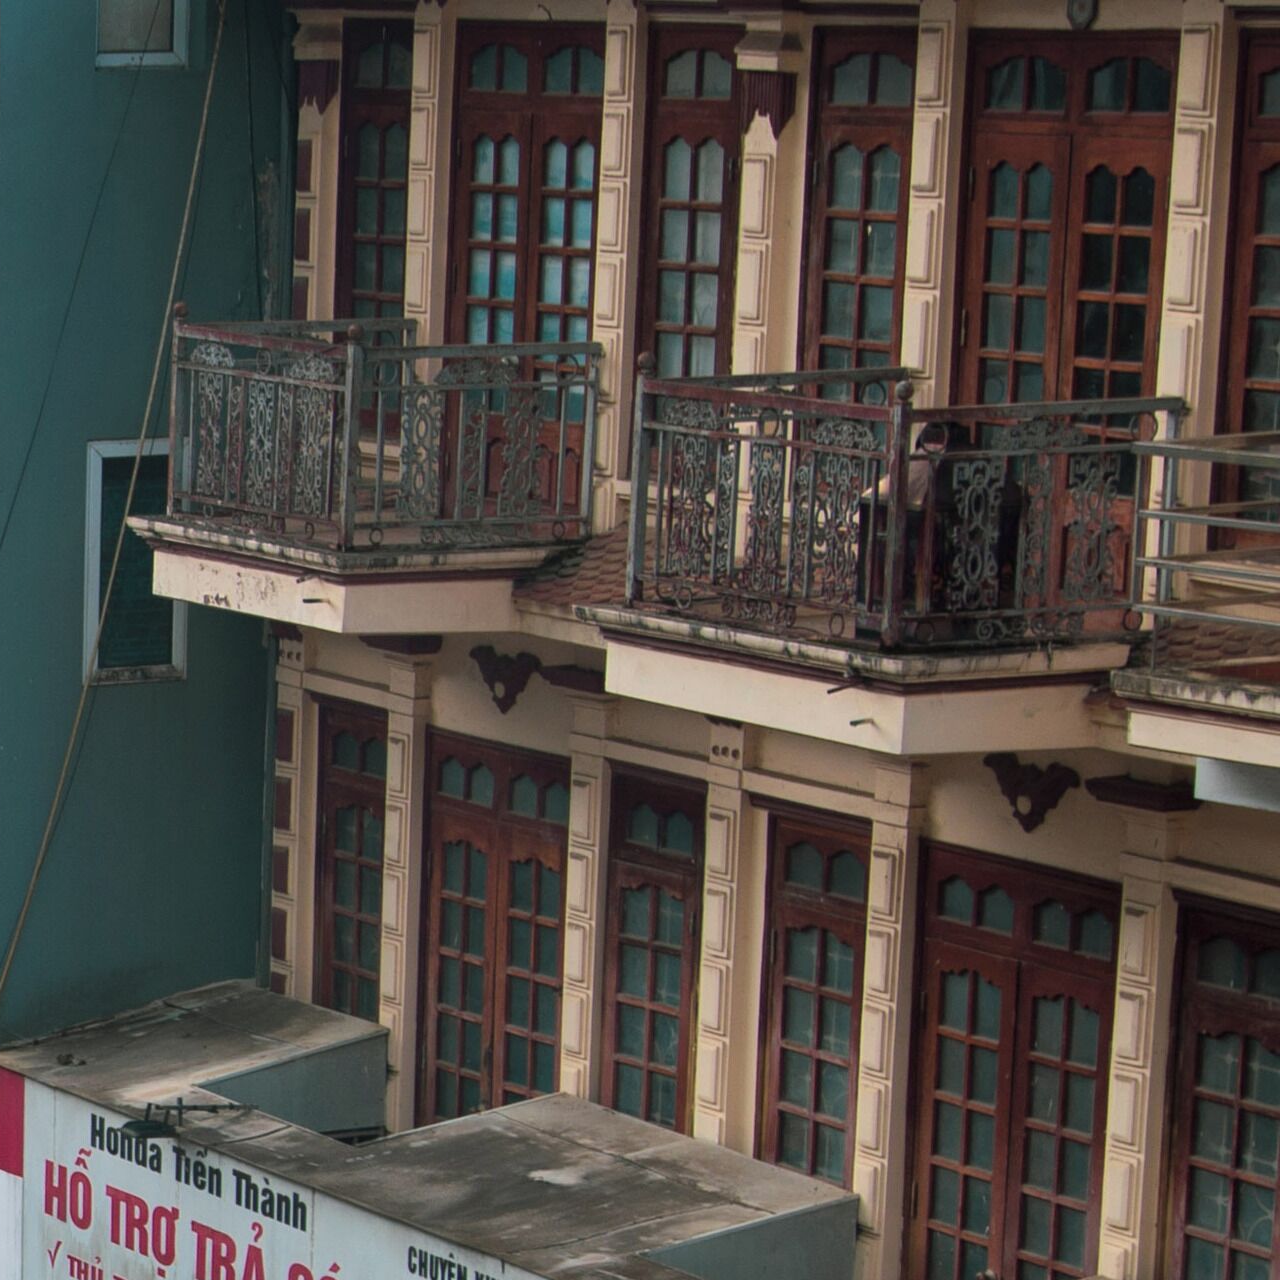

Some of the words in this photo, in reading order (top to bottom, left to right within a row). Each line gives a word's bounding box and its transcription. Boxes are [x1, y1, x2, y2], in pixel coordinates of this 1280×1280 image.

[43, 1147, 93, 1232] HỖ
[105, 1185, 180, 1279] TRỢ
[172, 1147, 223, 1198] Tiến
[232, 1169, 308, 1232] Thành
